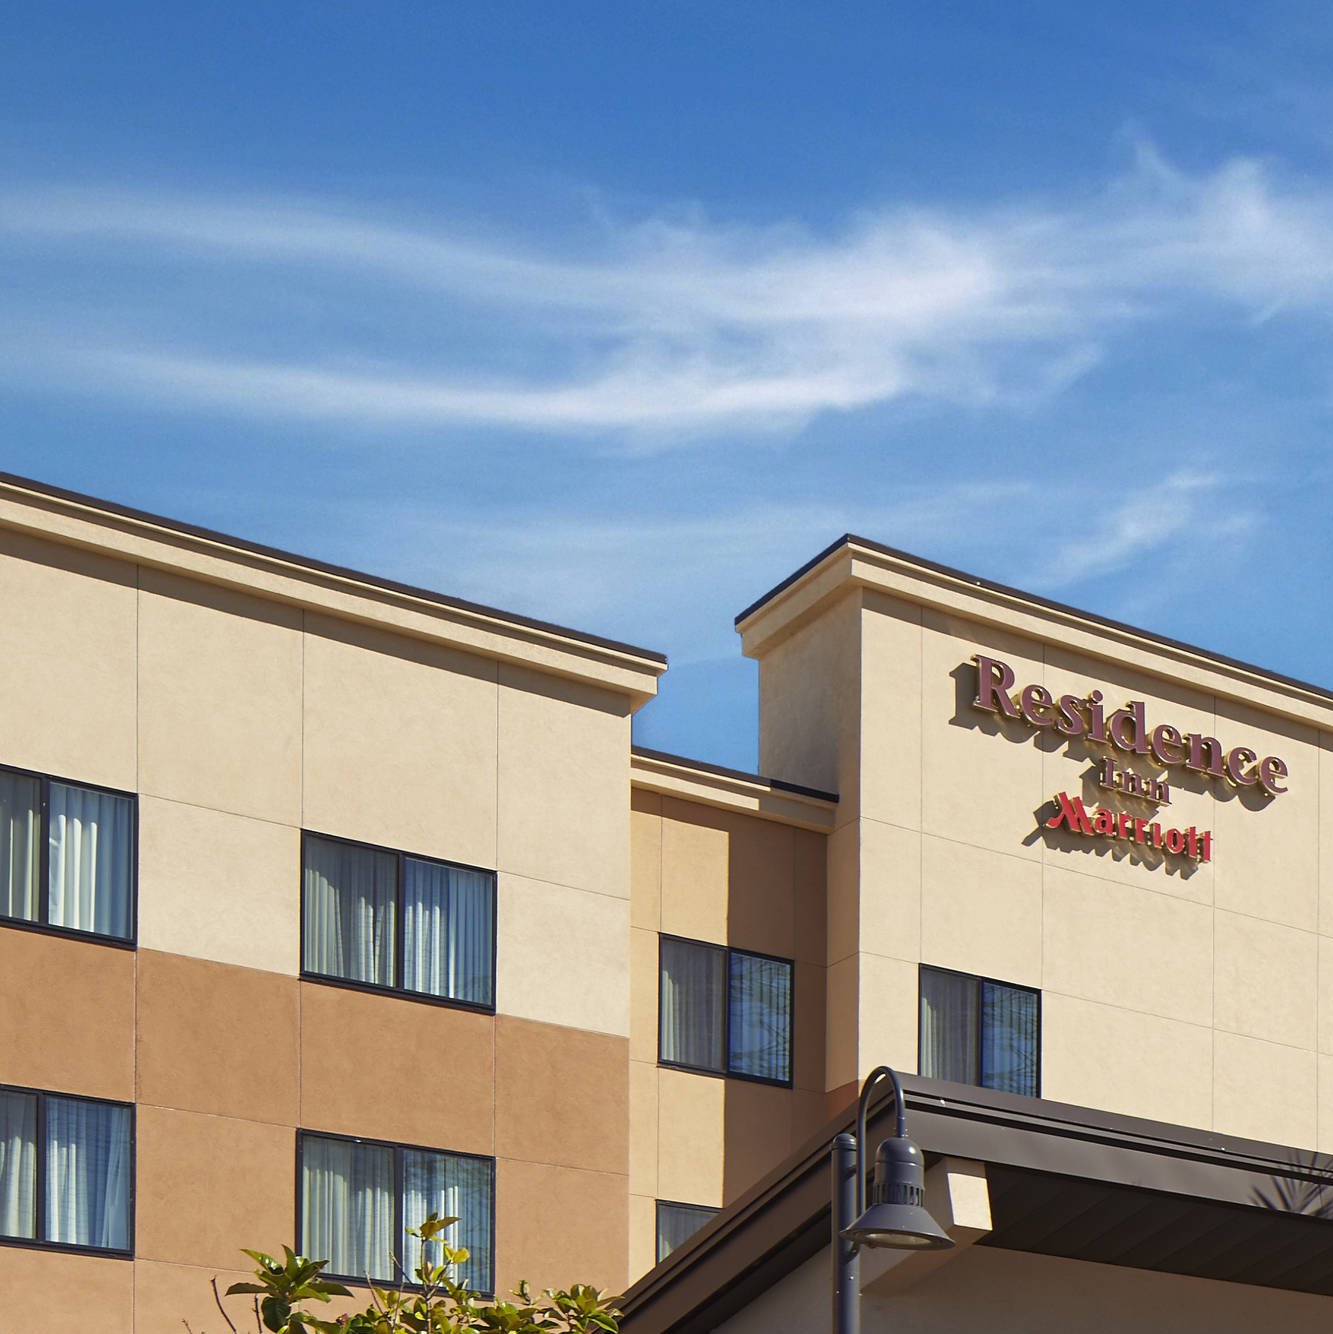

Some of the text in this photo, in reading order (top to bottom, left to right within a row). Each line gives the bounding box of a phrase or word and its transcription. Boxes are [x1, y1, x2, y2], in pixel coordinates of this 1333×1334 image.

[971, 653, 1290, 796] Residence
[1100, 755, 1173, 807] Inn
[1046, 791, 1214, 863] Marriott
